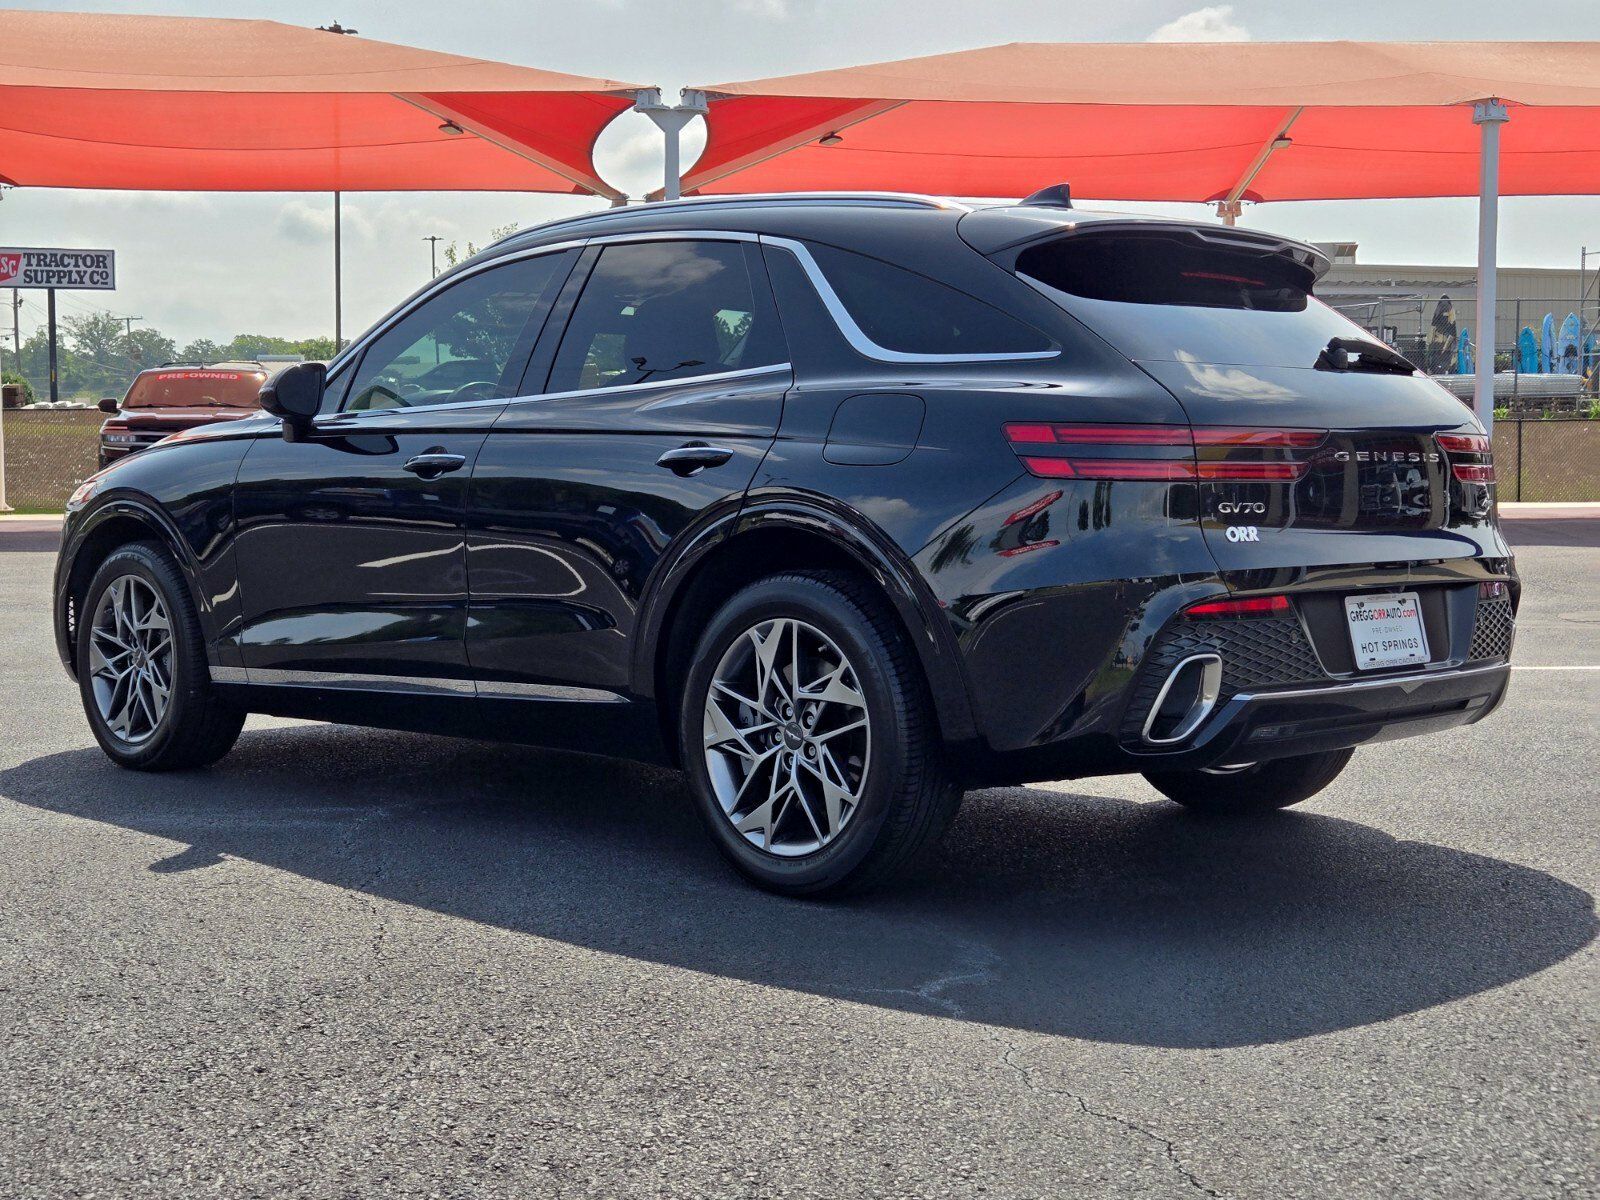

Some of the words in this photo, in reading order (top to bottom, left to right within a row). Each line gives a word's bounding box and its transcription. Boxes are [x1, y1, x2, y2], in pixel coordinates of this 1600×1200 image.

[0, 256, 17, 277] SC
[23, 253, 108, 269] TRACTOR
[23, 269, 88, 285] SUPPLY
[158, 372, 239, 380] PRE-OWNED
[1334, 451, 1440, 463] GENESIS
[1218, 502, 1266, 514] GV70
[1225, 526, 1260, 543] ORR
[1350, 607, 1416, 621] GREGGORRAUTO.com
[1361, 641, 1380, 654] HOT
[1382, 638, 1419, 651] SPRINGS
